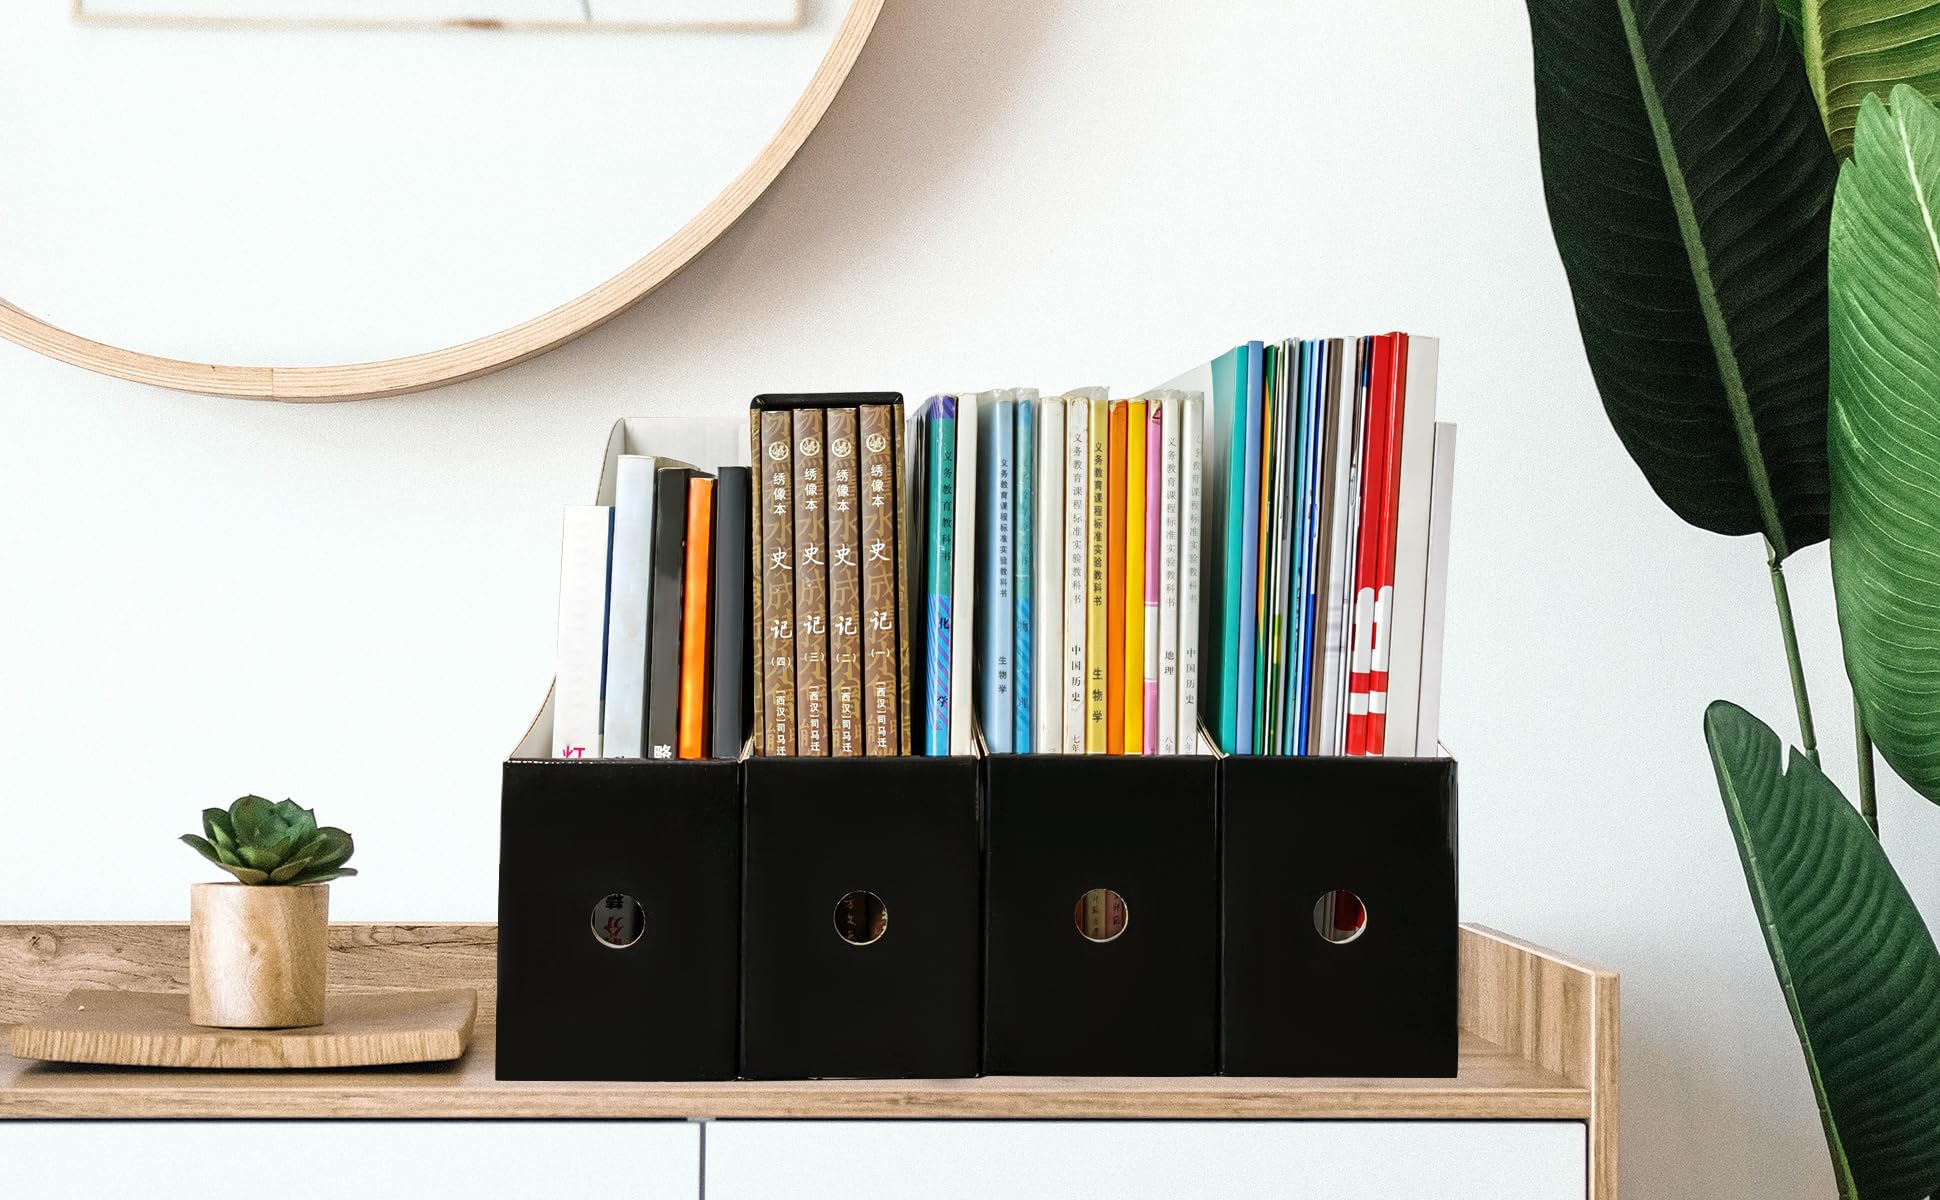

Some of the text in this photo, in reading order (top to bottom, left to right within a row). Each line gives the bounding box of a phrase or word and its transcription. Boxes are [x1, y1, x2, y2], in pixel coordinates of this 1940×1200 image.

[772, 473, 787, 516] 绣像本
[804, 468, 818, 512] 绣像本
[836, 469, 850, 513] 绣像本
[871, 464, 885, 508] 绣像本
[942, 451, 953, 561] 义务教育教科书
[999, 458, 1008, 597] 义务教育课程标准实验教科书
[1073, 433, 1083, 604] 义务教育课程标准实验教科书
[1092, 442, 1103, 606] 义务教育课程标准实验教科书
[1165, 438, 1177, 607] 义务教育课程标准实验教科书
[769, 546, 793, 639] 史记
[802, 542, 825, 635] 史记
[834, 543, 857, 636] 史记
[868, 538, 892, 631] 史记
[937, 617, 950, 707] 化学
[997, 656, 1008, 694] 生物学
[1071, 645, 1081, 703] 中国历史
[1092, 668, 1103, 723] 生物学
[1164, 650, 1175, 676] 地理
[1185, 647, 1197, 705] 中国历史
